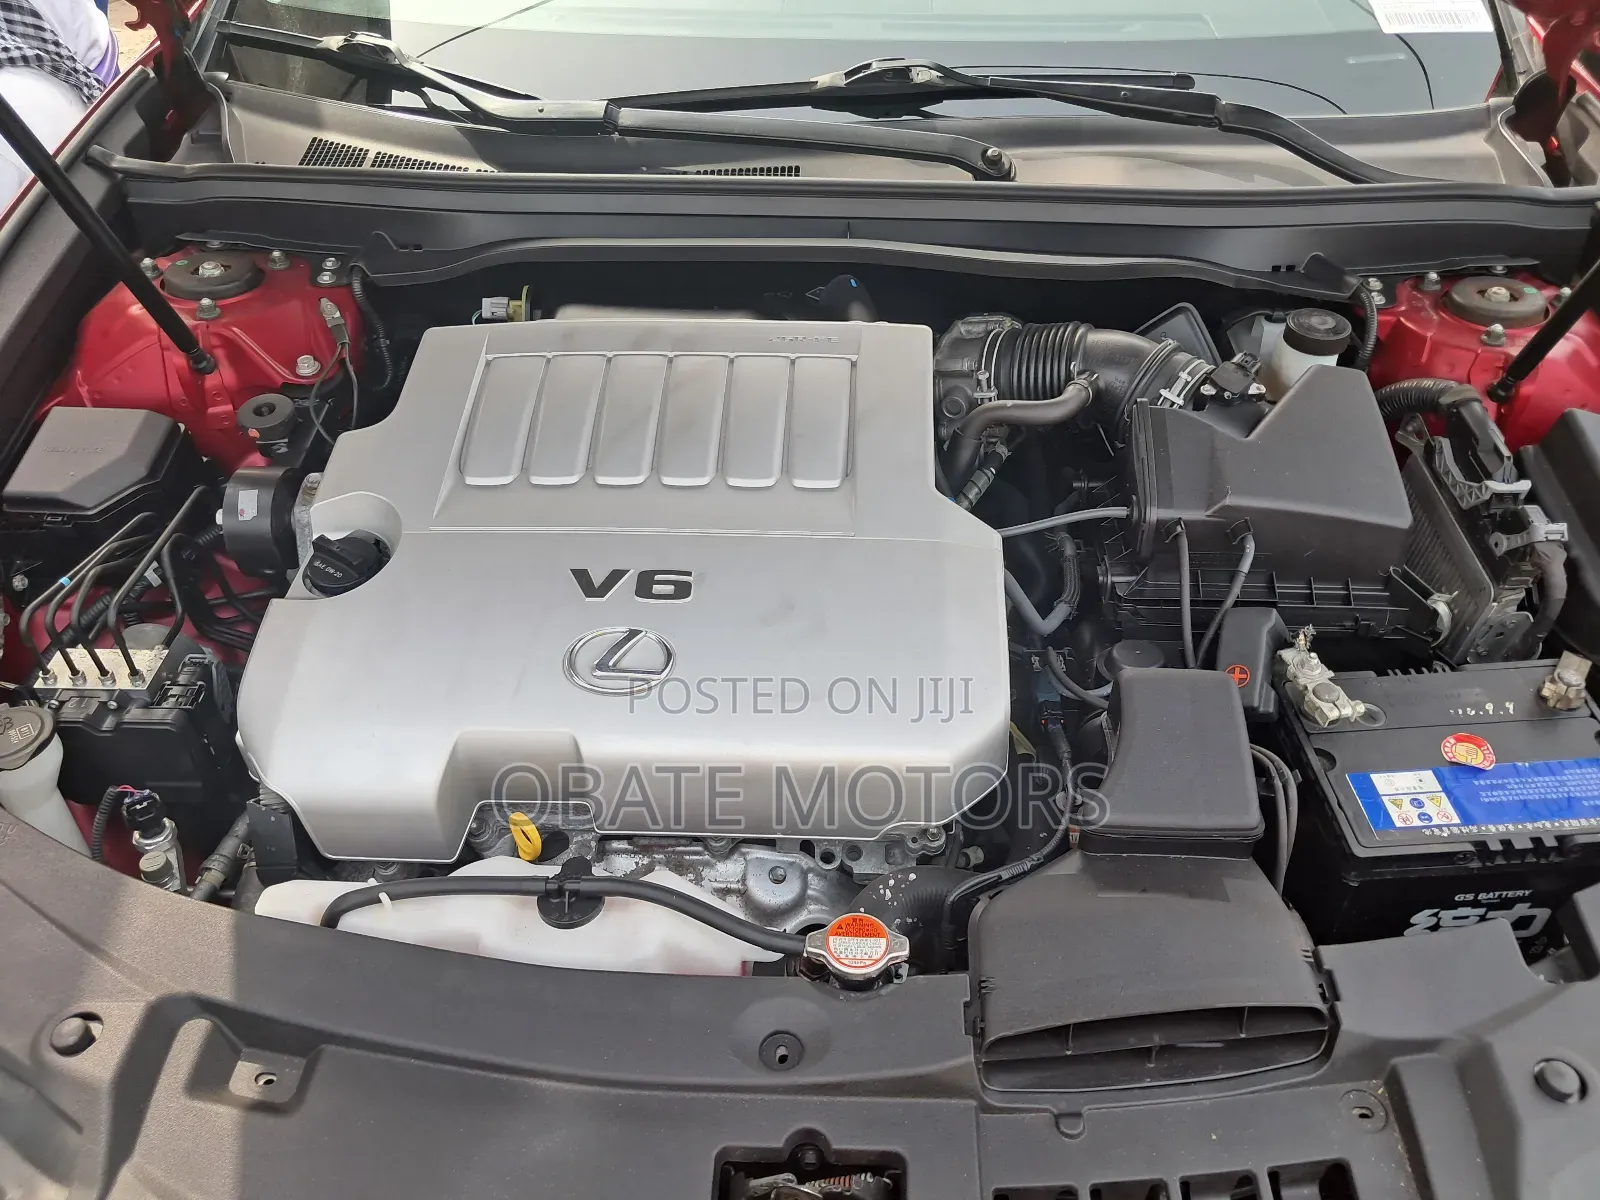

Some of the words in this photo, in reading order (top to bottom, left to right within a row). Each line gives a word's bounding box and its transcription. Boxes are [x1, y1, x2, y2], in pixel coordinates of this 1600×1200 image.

[569, 568, 694, 603] V6
[1454, 893, 1475, 902] GS
[1477, 889, 1533, 900] BATTERY
